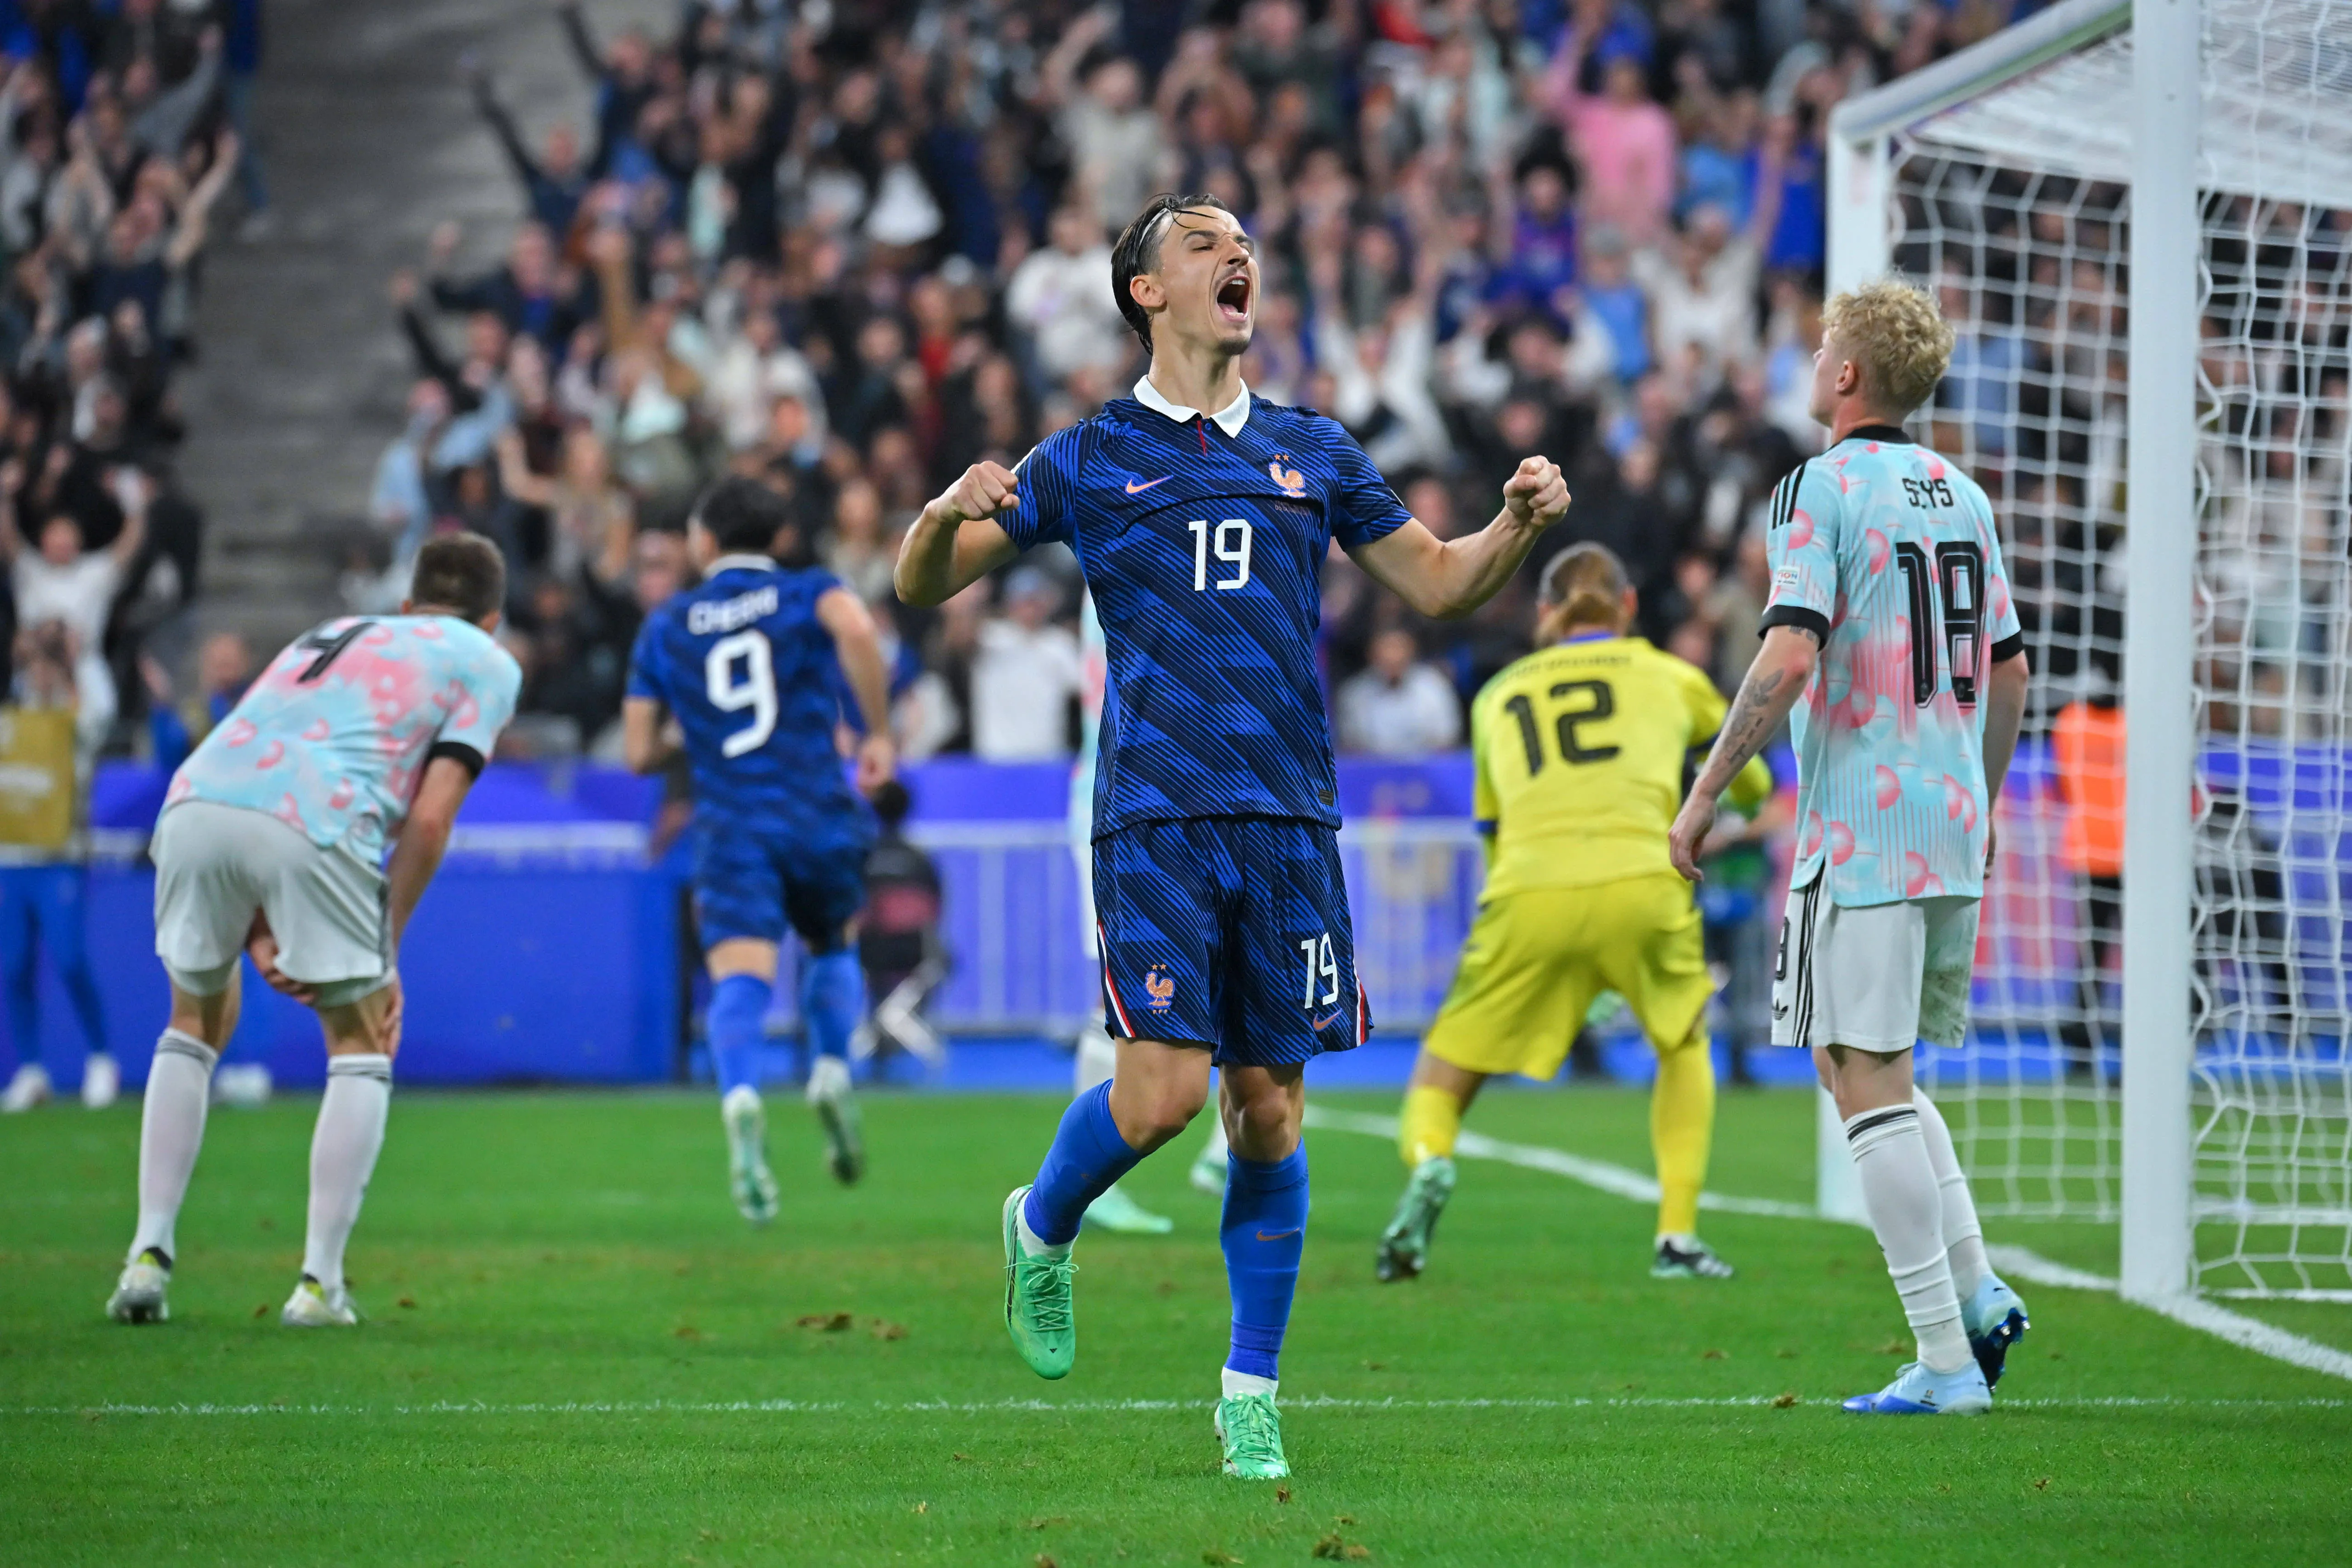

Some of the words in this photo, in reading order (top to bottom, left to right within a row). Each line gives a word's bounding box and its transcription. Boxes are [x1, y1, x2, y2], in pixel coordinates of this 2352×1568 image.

[1189, 519, 1252, 591] 19
[1896, 541, 1984, 710] 18
[705, 631, 778, 758] 9
[1504, 680, 1620, 776] 12
[1301, 932, 1339, 1009] 19
